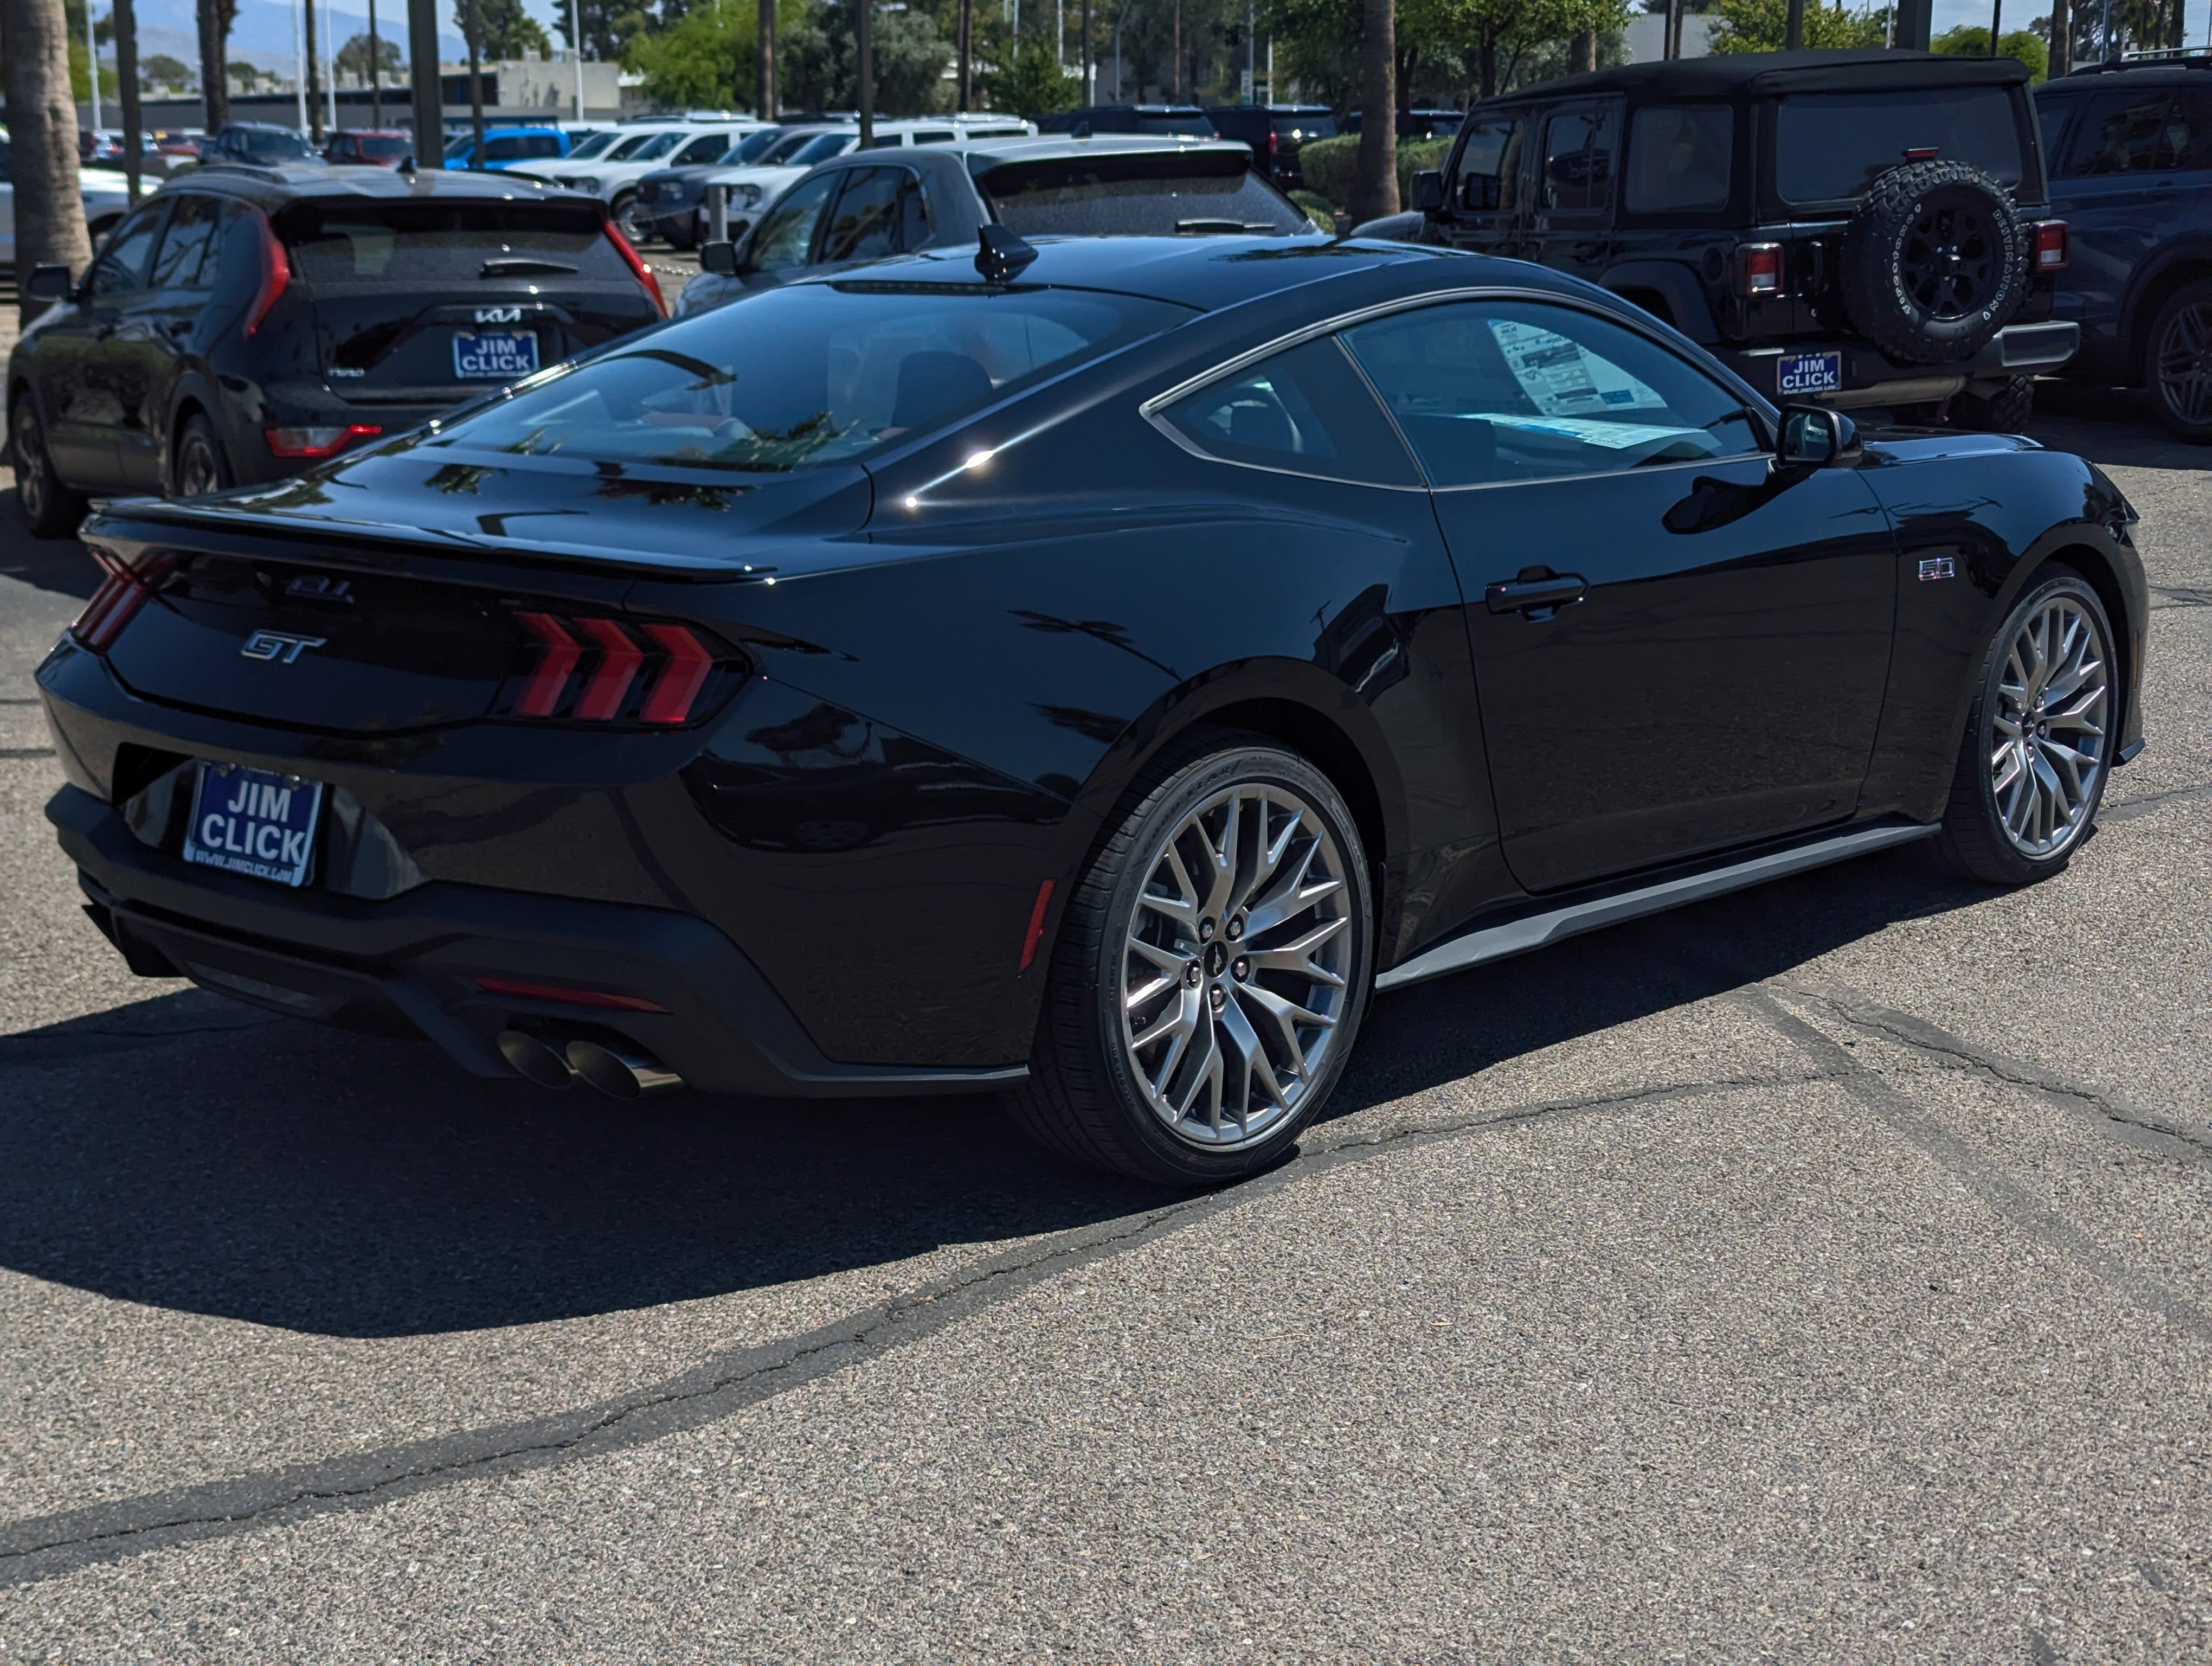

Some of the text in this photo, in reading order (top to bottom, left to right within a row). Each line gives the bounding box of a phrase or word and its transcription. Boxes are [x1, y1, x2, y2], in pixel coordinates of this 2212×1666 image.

[1990, 209, 2014, 312] DESTINATION
[475, 309, 522, 323] KIA
[475, 339, 516, 355] JIM
[462, 355, 530, 370] CLICK
[1793, 359, 1824, 374] JIM
[1782, 371, 1835, 388] CLICK
[240, 629, 329, 664] GT
[228, 780, 292, 823] JIM
[202, 813, 306, 864] CLICK
